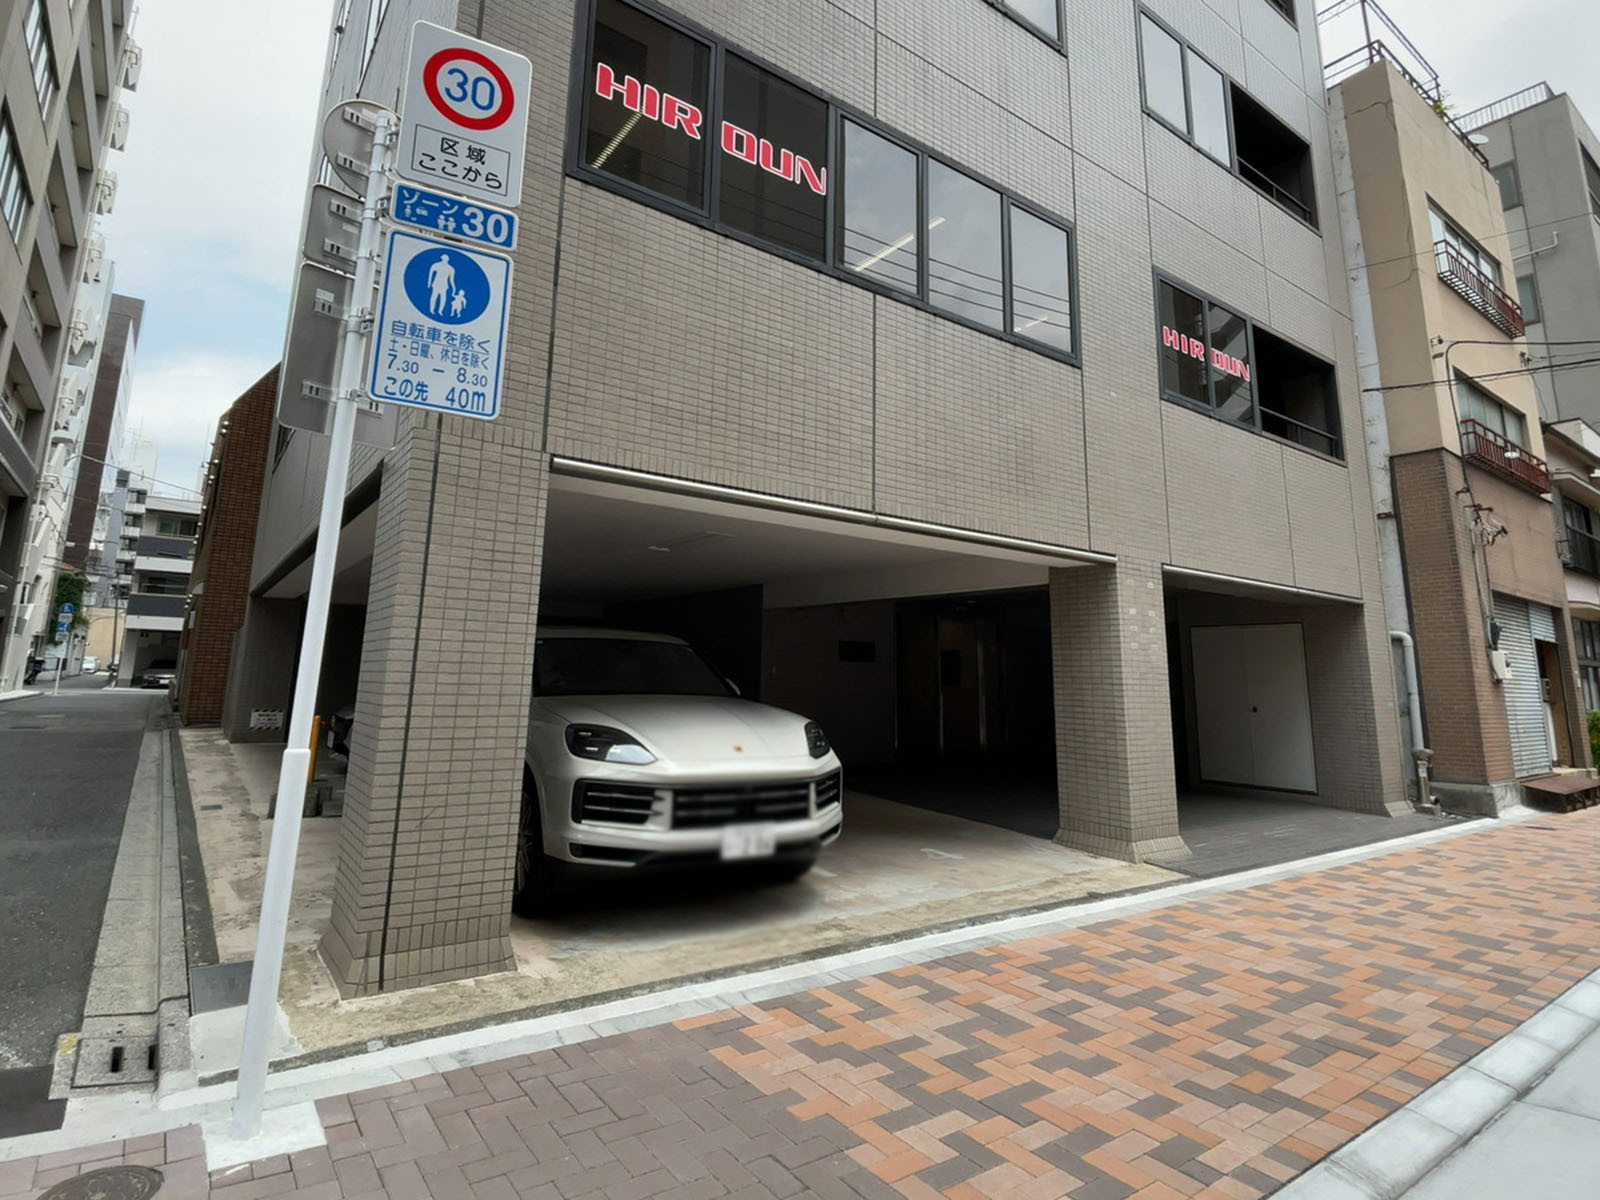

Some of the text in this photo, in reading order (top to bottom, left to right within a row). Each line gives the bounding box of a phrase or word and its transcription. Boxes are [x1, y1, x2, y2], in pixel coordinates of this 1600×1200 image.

[445, 67, 495, 111] 30
[595, 62, 827, 196] HIR OUN
[440, 137, 486, 165] 区域
[419, 153, 502, 190] ここから
[403, 189, 508, 243] ゾーン 30
[391, 320, 490, 355] 自転車を除く
[1163, 326, 1205, 361] HIR
[387, 353, 419, 374] 7.30
[457, 367, 488, 388] 8.30
[384, 376, 486, 412] この先 40m
